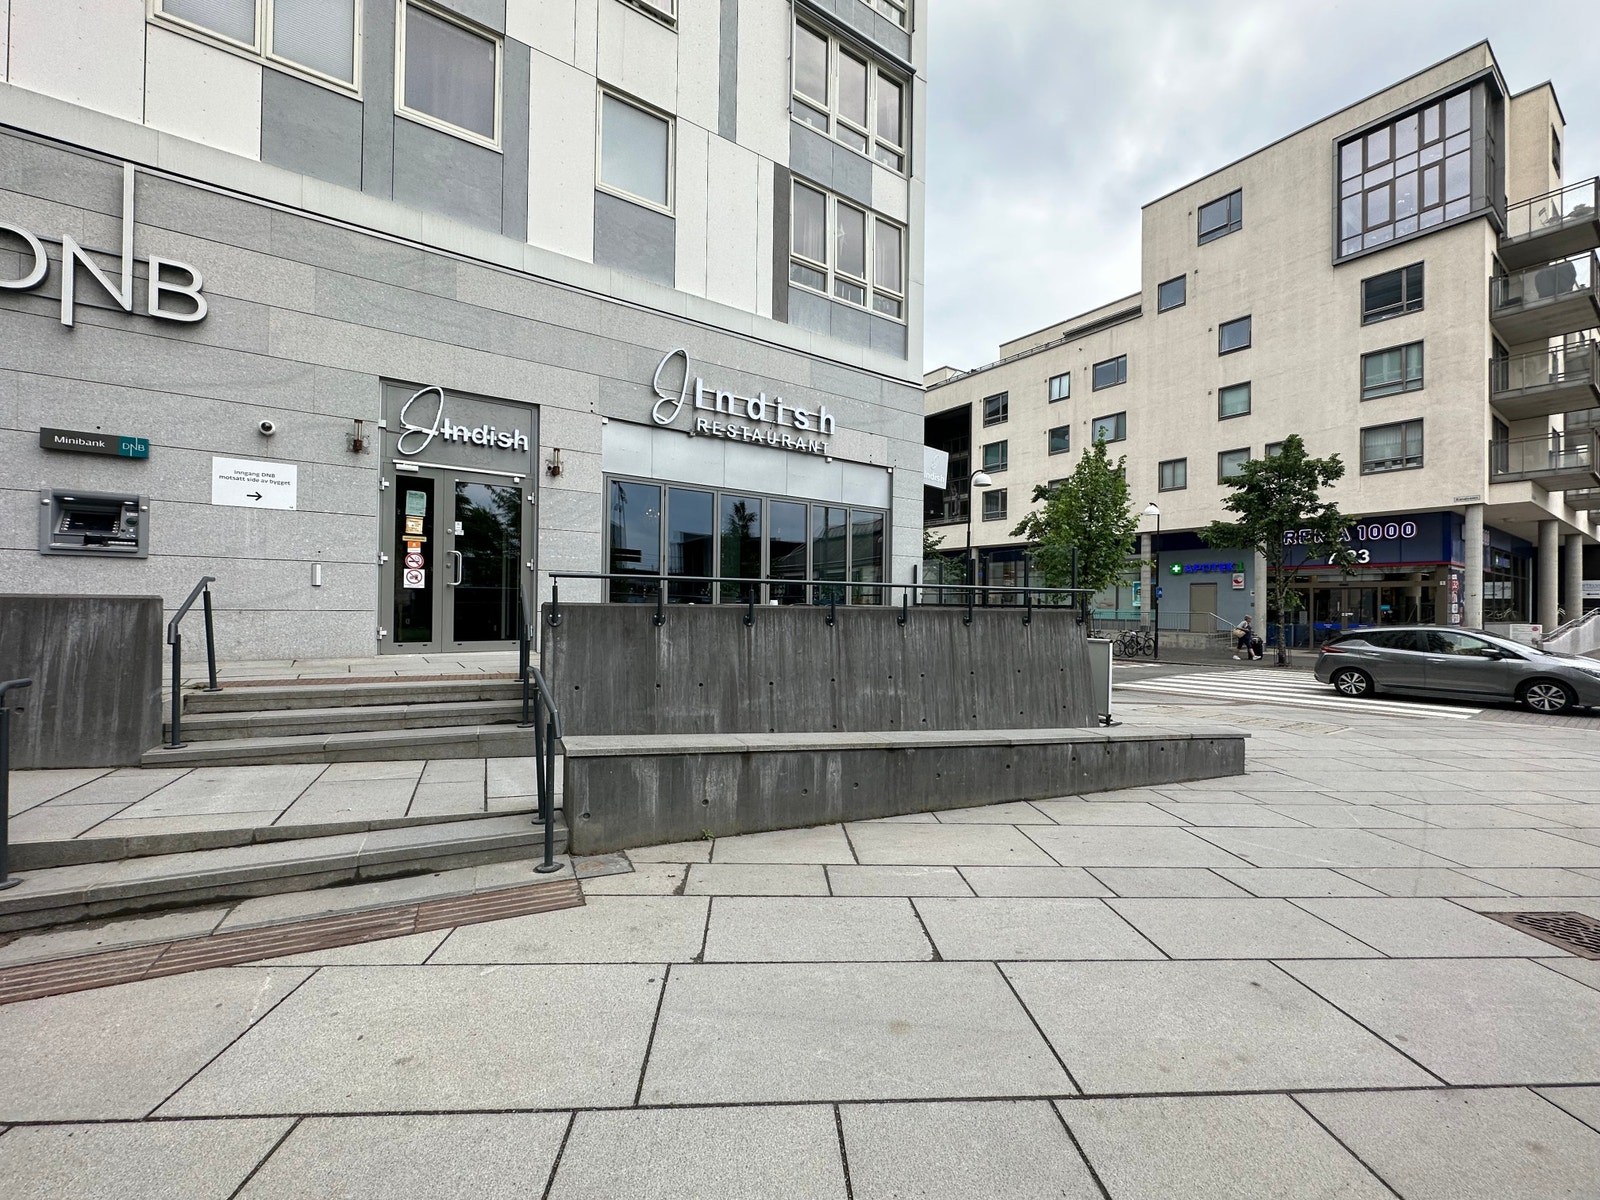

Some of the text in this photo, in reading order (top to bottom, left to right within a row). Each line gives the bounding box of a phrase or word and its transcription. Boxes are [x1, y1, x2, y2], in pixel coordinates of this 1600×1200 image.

[0, 162, 208, 327] DNB
[54, 435, 106, 448] Minibank
[442, 418, 529, 451] Indish
[696, 417, 829, 455] RESTAURANT
[122, 437, 145, 457] DNB
[218, 474, 246, 482] motsatt
[1356, 521, 1416, 541] 1000
[1184, 562, 1235, 574] APOTEK
